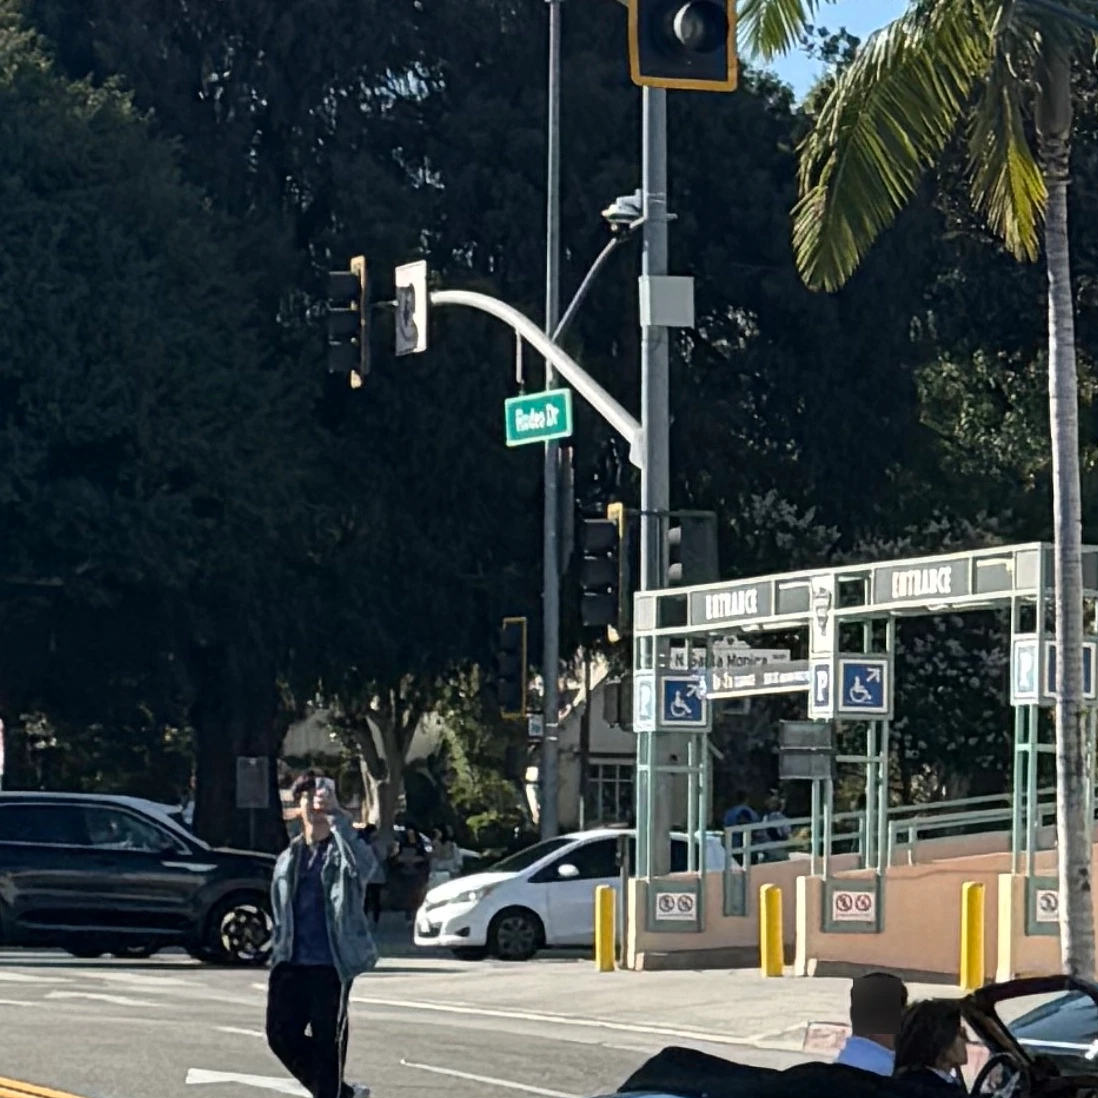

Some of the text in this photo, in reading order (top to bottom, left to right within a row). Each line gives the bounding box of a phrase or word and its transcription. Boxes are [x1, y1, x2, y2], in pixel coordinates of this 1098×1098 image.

[515, 403, 559, 432] Rodeo Dr
[892, 565, 952, 599] ENTRANCE
[705, 588, 758, 620] ENTRANCE
[817, 670, 828, 701] P
